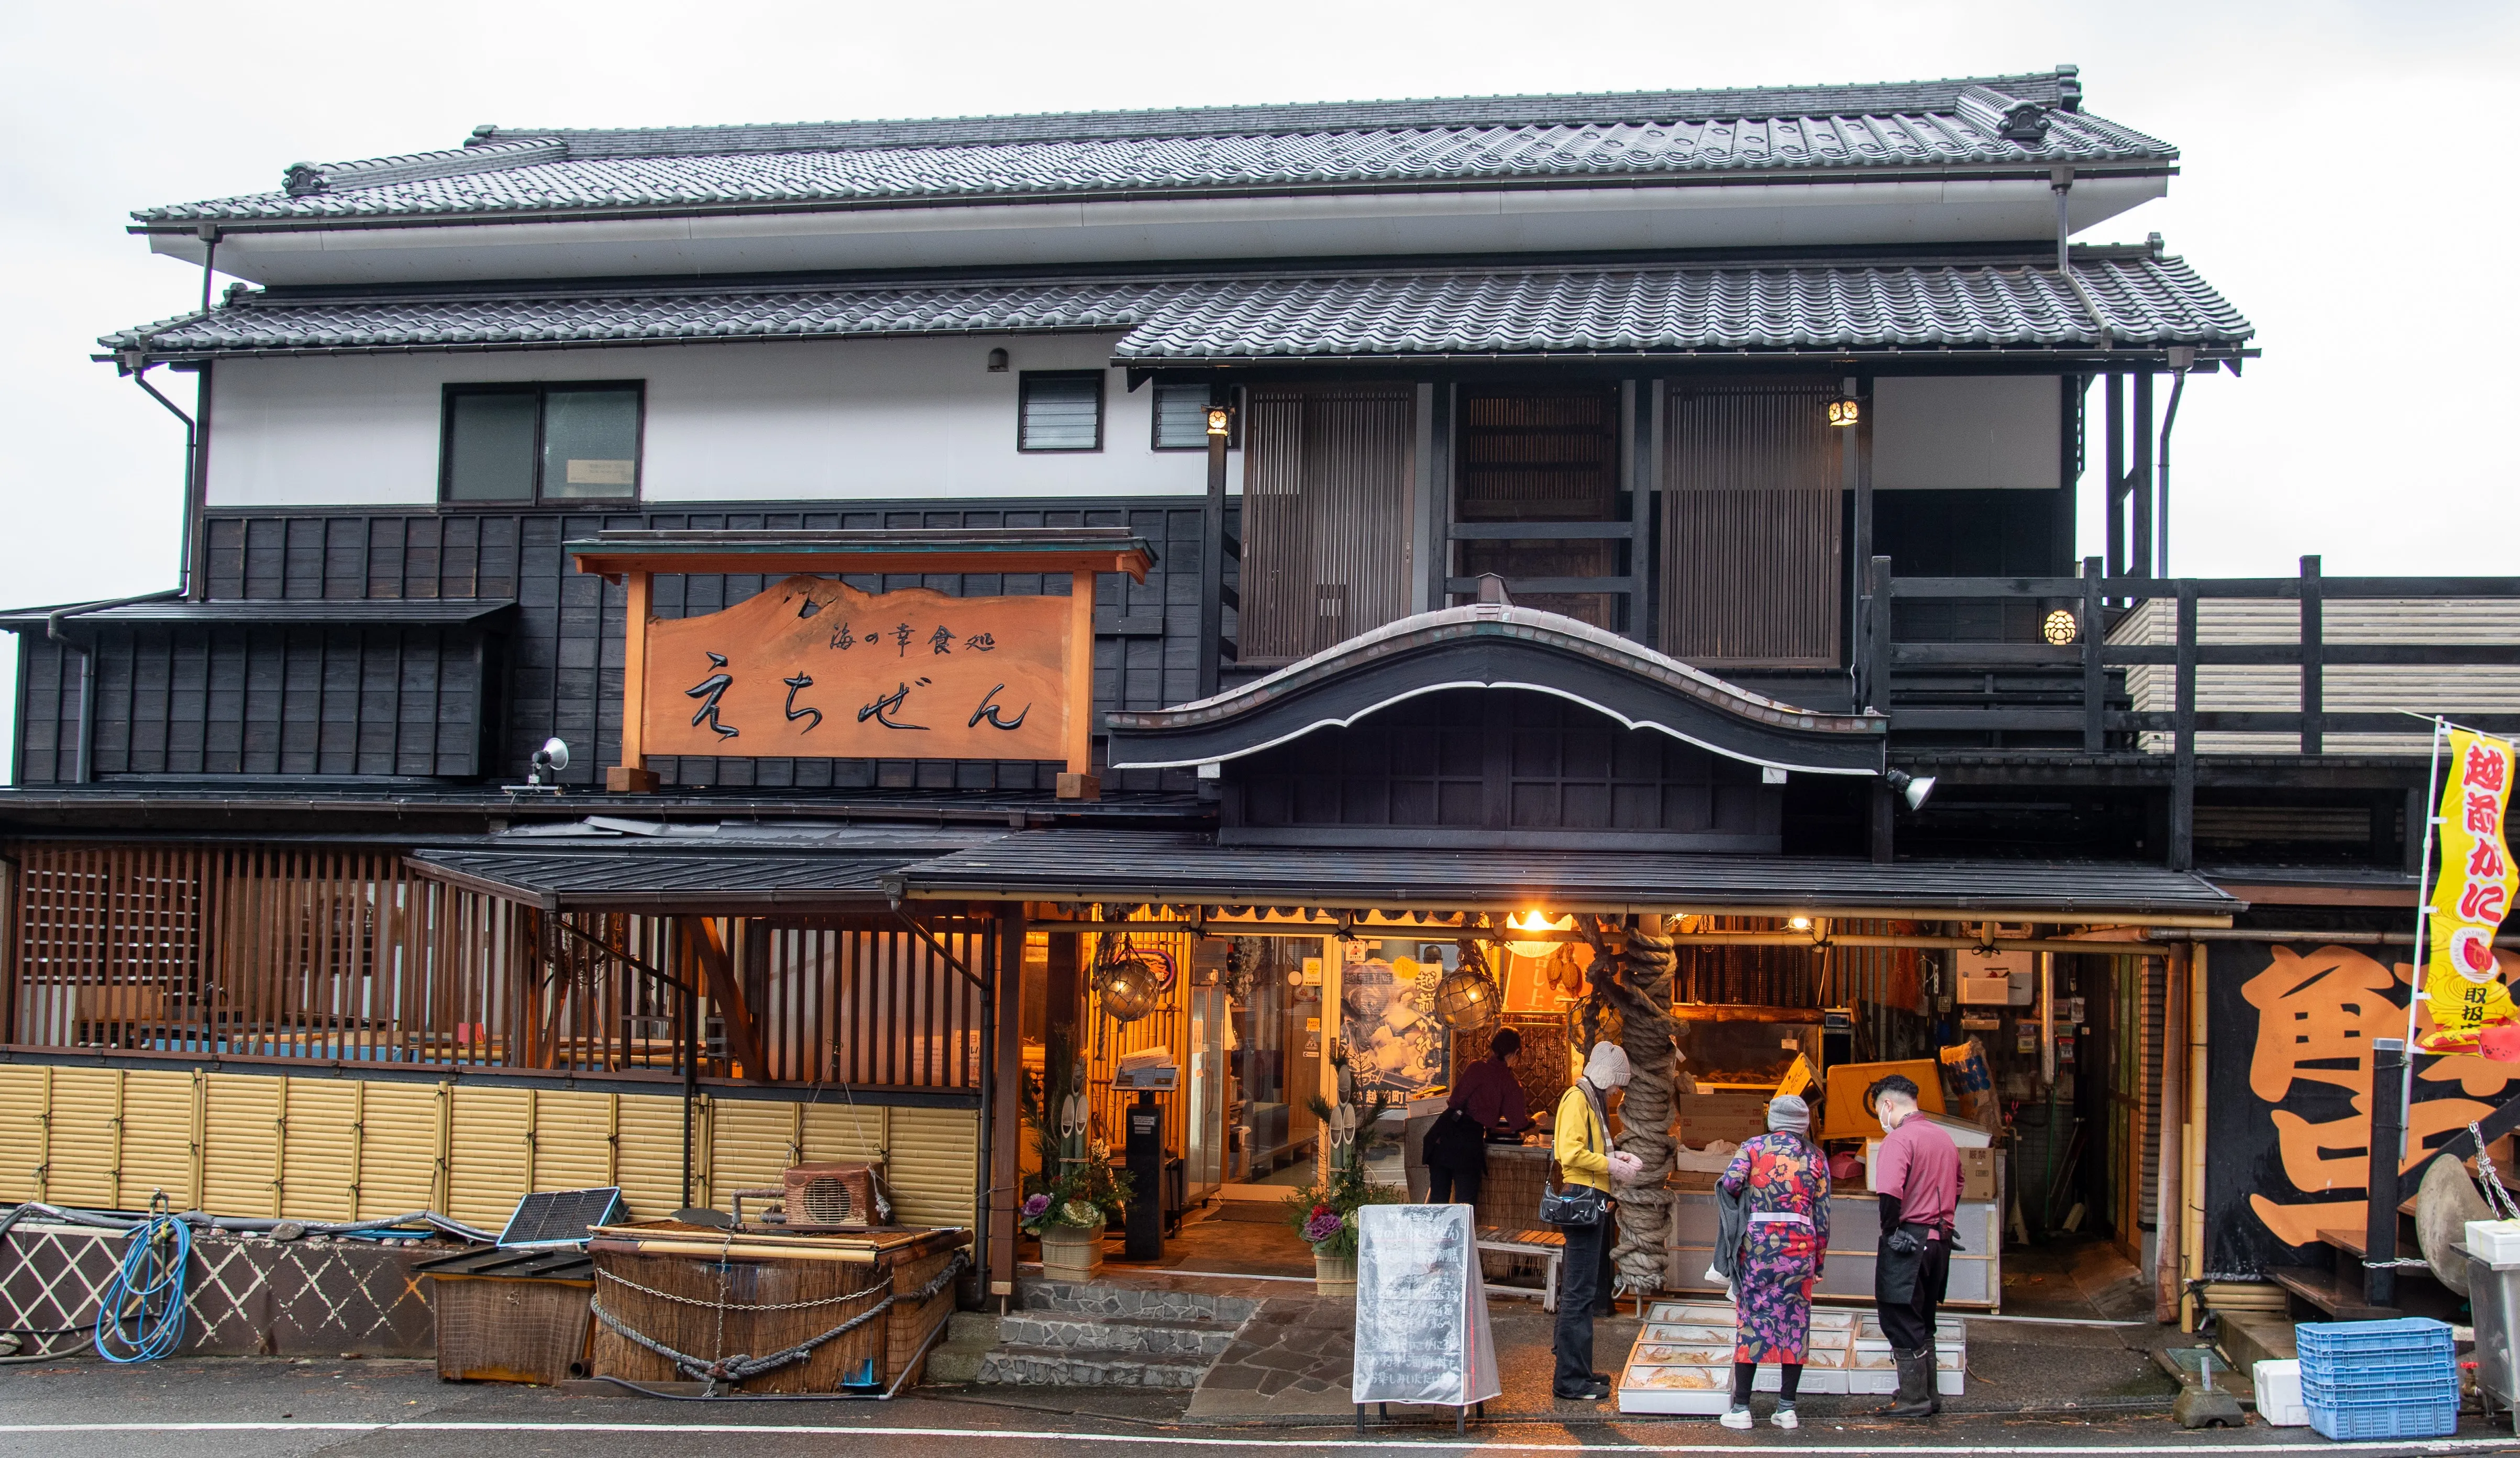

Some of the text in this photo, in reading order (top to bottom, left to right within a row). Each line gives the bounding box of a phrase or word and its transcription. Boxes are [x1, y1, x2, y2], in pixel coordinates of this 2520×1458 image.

[830, 622, 996, 658] 海の幸食処
[684, 651, 1032, 743] えちぜん
[2461, 986, 2488, 1029] 取扱
